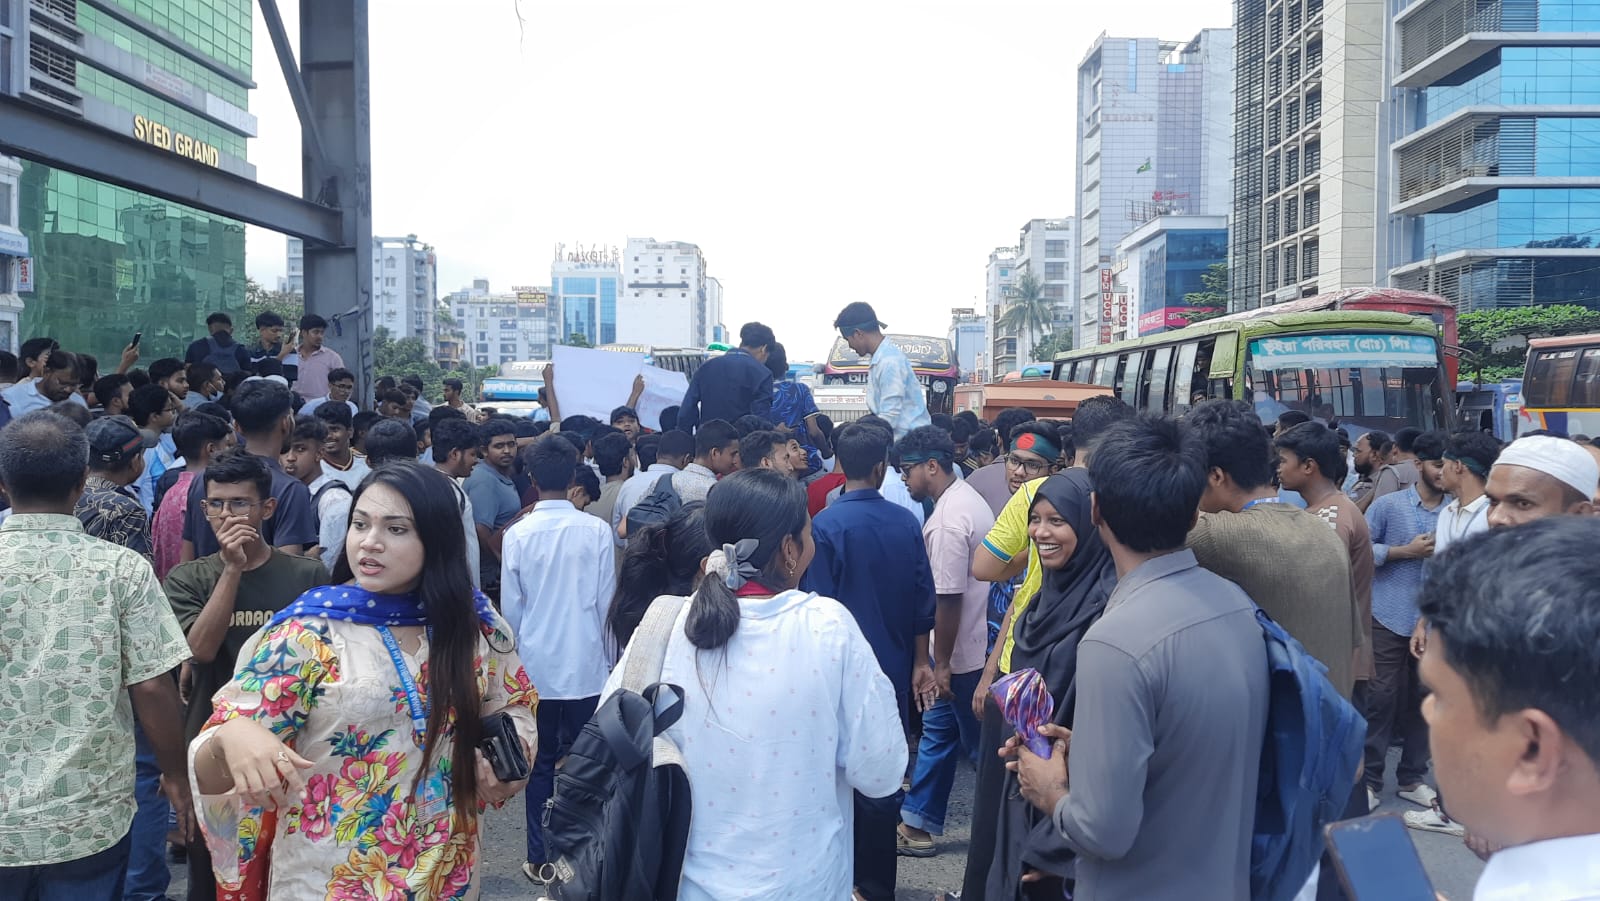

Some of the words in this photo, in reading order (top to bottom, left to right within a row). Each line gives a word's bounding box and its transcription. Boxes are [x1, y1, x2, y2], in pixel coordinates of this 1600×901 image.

[134, 114, 171, 150] SYED
[175, 132, 219, 169] GRAND
[229, 610, 275, 627] RDAN
[410, 691, 423, 717] NAWAB
